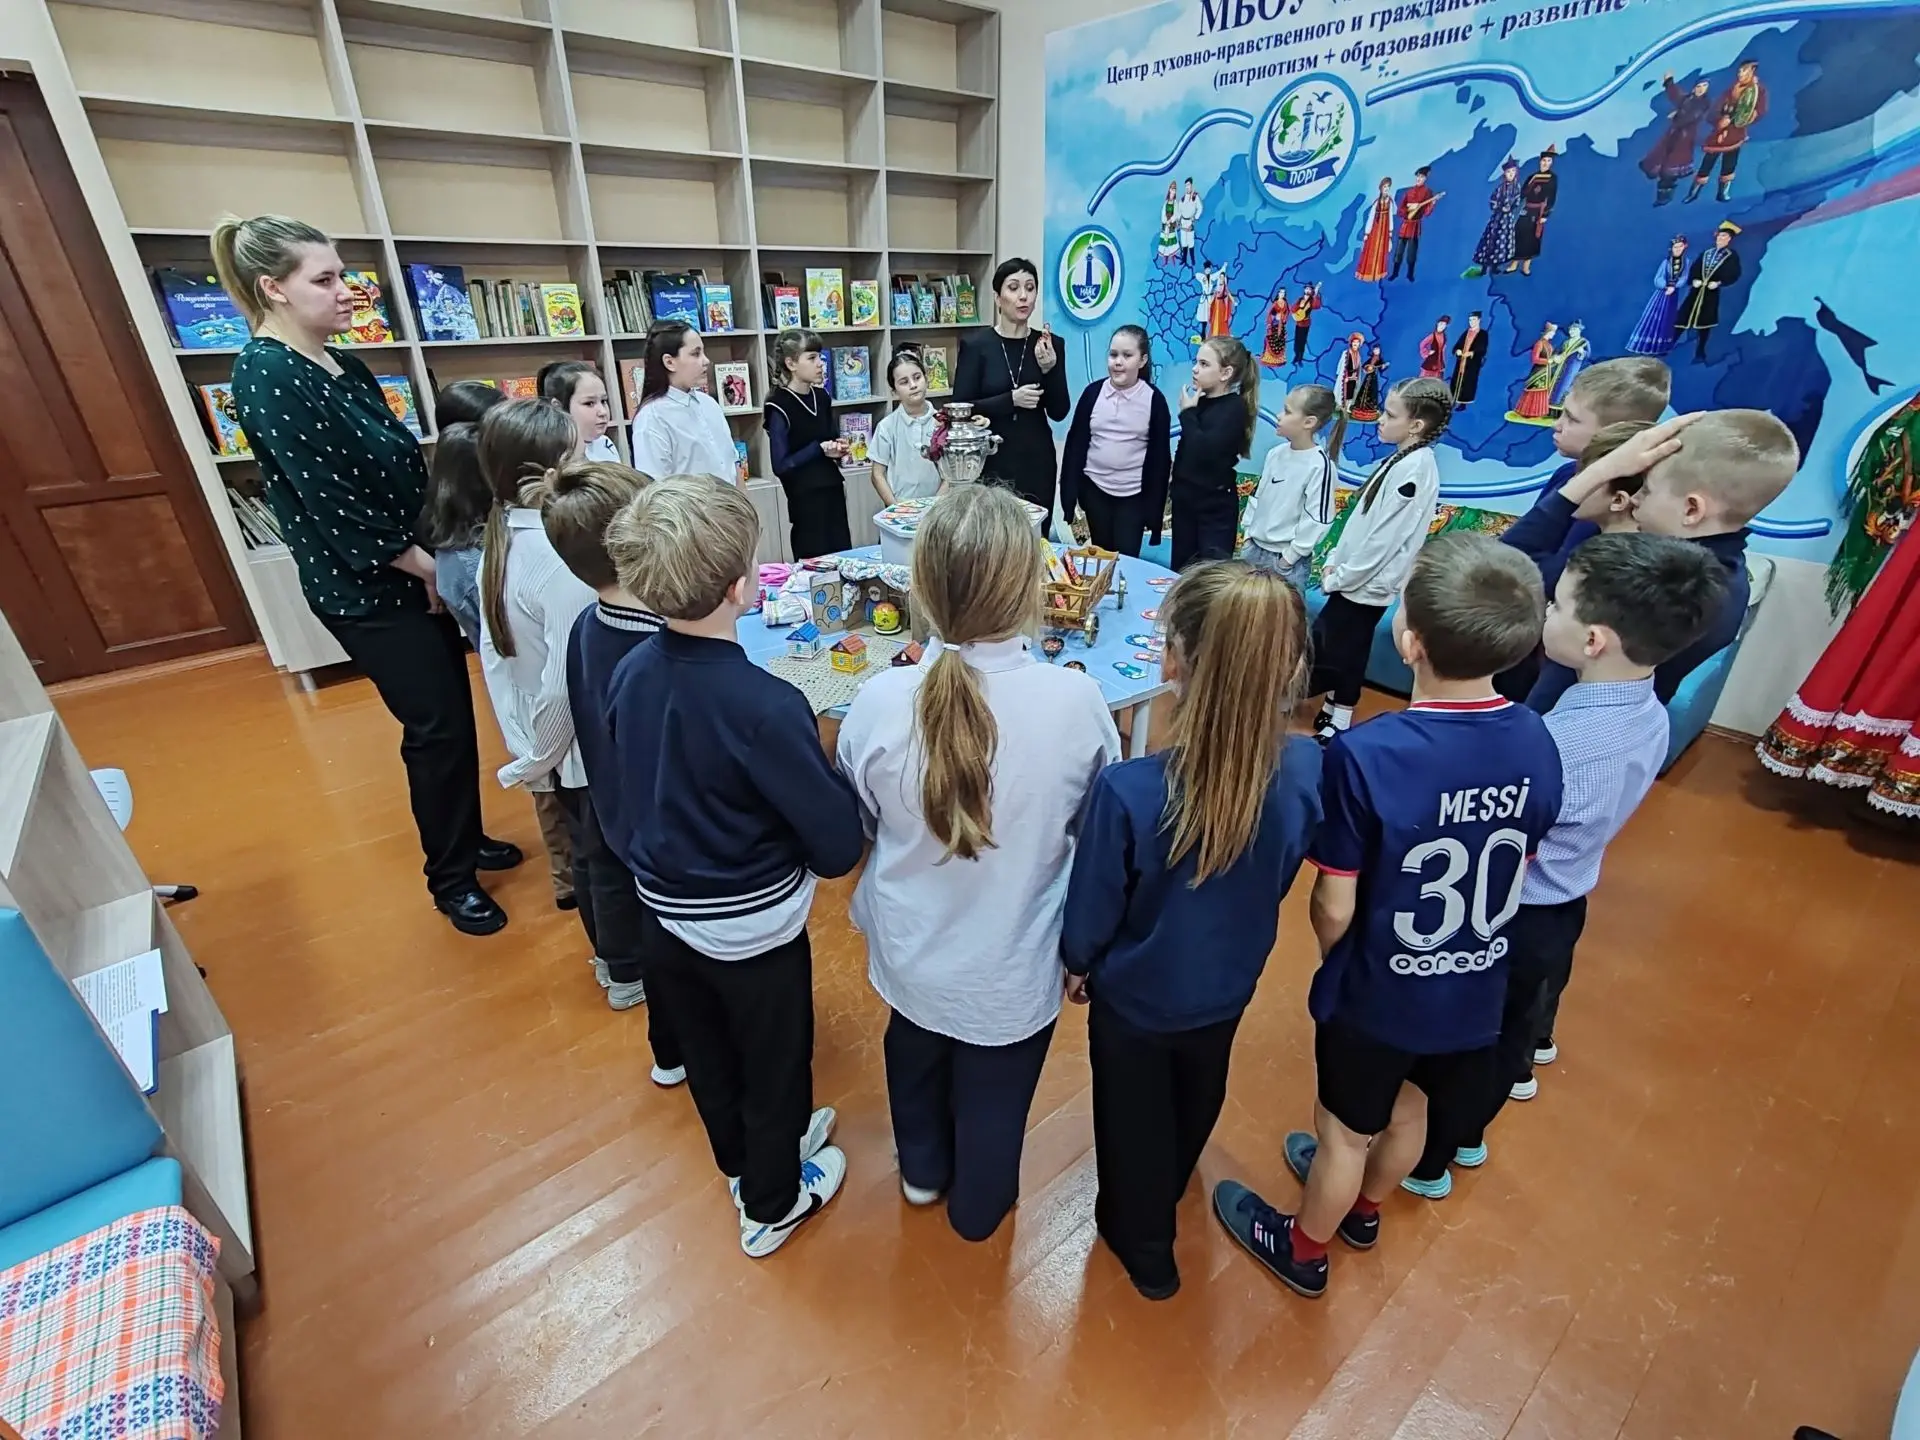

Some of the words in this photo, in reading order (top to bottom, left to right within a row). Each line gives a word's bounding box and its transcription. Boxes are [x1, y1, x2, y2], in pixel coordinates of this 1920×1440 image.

[1106, 63, 1149, 85] Центр
[1151, 18, 1345, 78] духовно-нравственного
[1351, 15, 1363, 32] и
[1213, 53, 1319, 91] (патриотизм
[1324, 48, 1336, 65] +
[1340, 23, 1473, 66] образование
[1479, 15, 1496, 36] +
[1289, 167, 1319, 186] ПОРТ
[1393, 828, 1528, 951] 30
